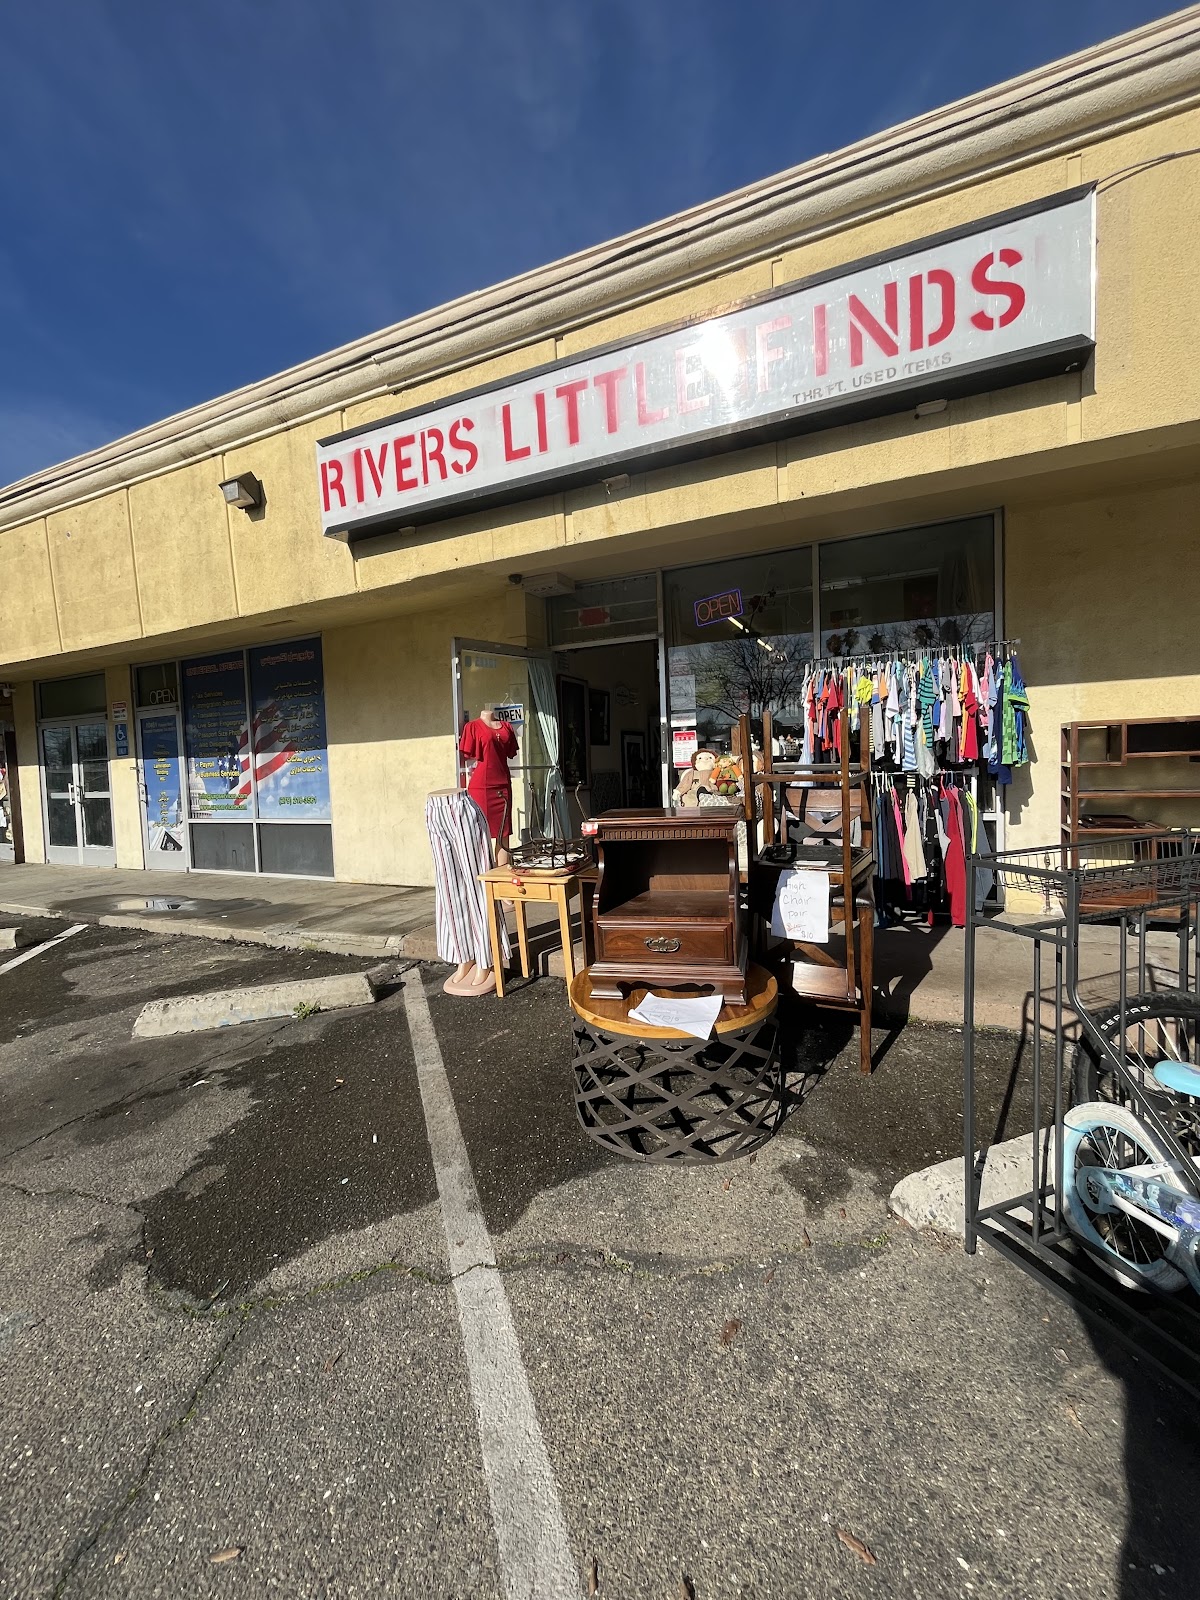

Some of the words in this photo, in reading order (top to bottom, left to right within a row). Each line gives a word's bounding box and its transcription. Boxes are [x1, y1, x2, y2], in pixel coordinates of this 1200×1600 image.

[321, 417, 479, 512] RIVERS
[501, 343, 716, 463] LITTLE
[755, 248, 1026, 393] FINDS
[793, 380, 847, 404] THRFT.
[852, 367, 897, 388] USED
[698, 592, 740, 621] OPEN
[186, 664, 218, 677] UNIVERSAL
[149, 689, 176, 704] OPEN
[498, 708, 522, 721] OPEN
[199, 761, 215, 769] Payroll
[783, 894, 811, 905] Chair
